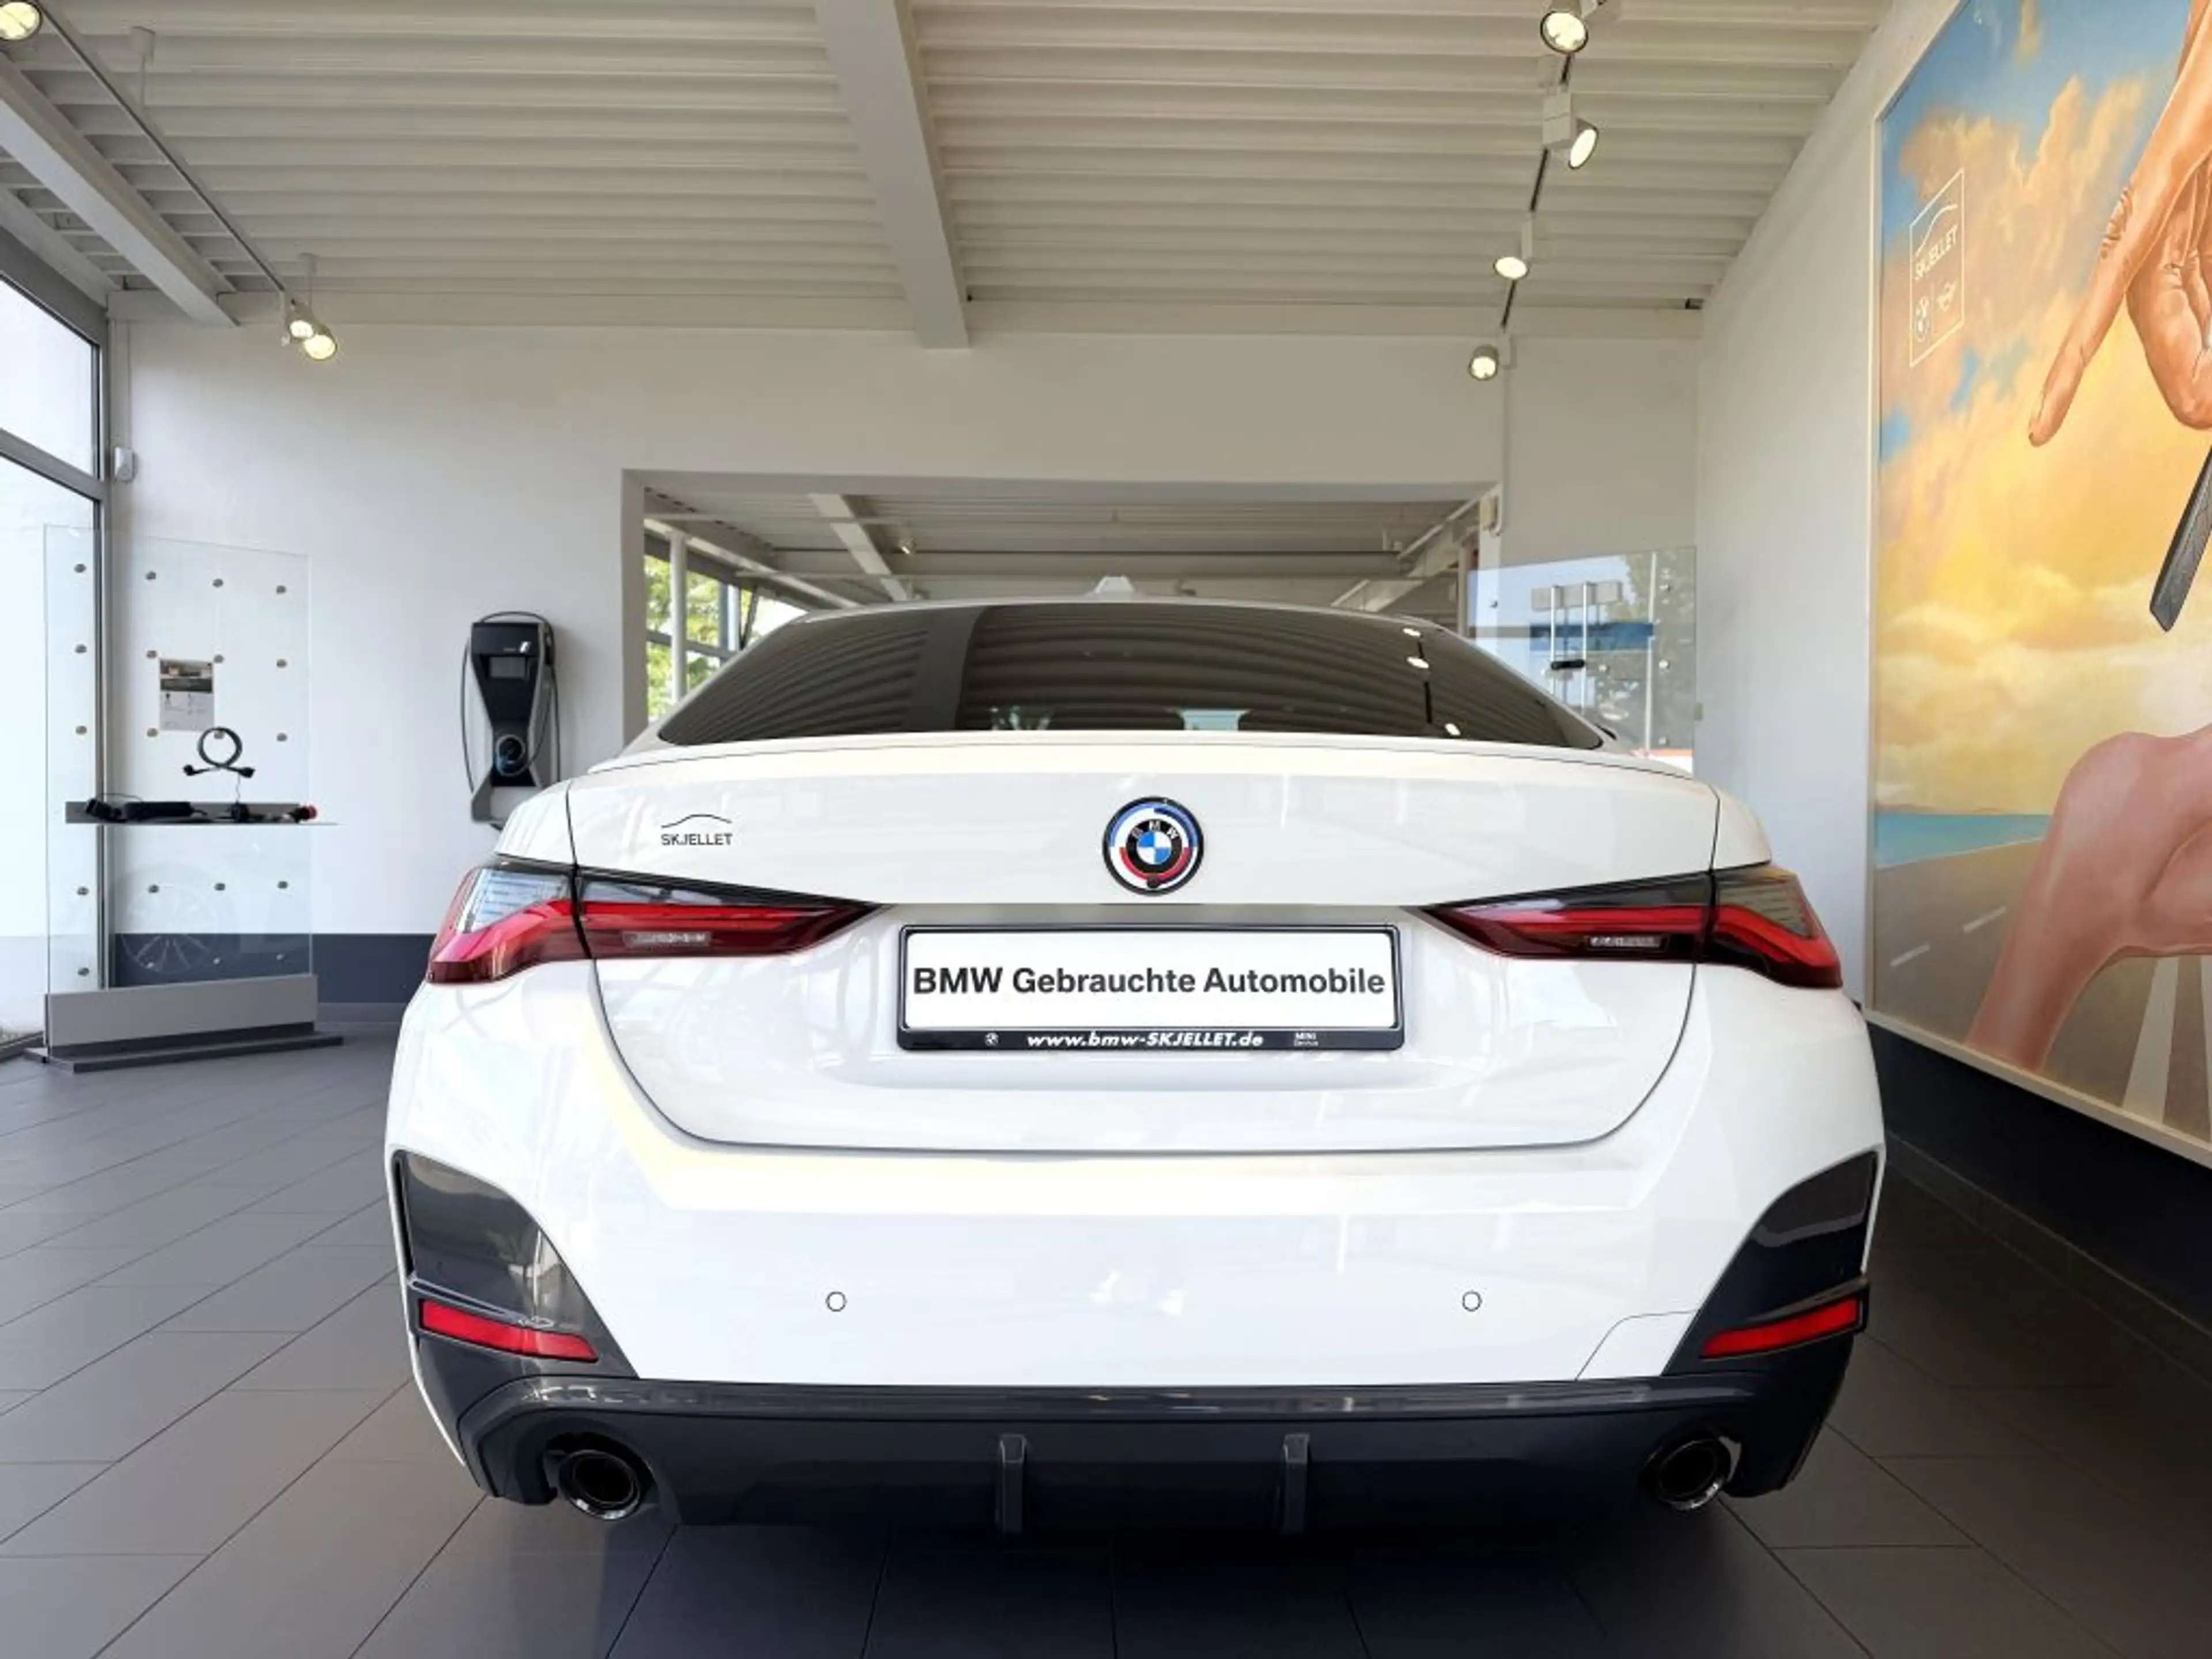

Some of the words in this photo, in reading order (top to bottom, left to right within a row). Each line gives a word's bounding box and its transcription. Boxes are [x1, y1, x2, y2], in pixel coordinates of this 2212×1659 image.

[661, 833, 733, 846] SKJELLET
[913, 967, 1003, 994] BMW
[1012, 967, 1196, 993] Gebrauchte
[1203, 967, 1385, 994] Automobile
[1027, 1031, 1264, 1047] www.bmw-SKJELLET.de
